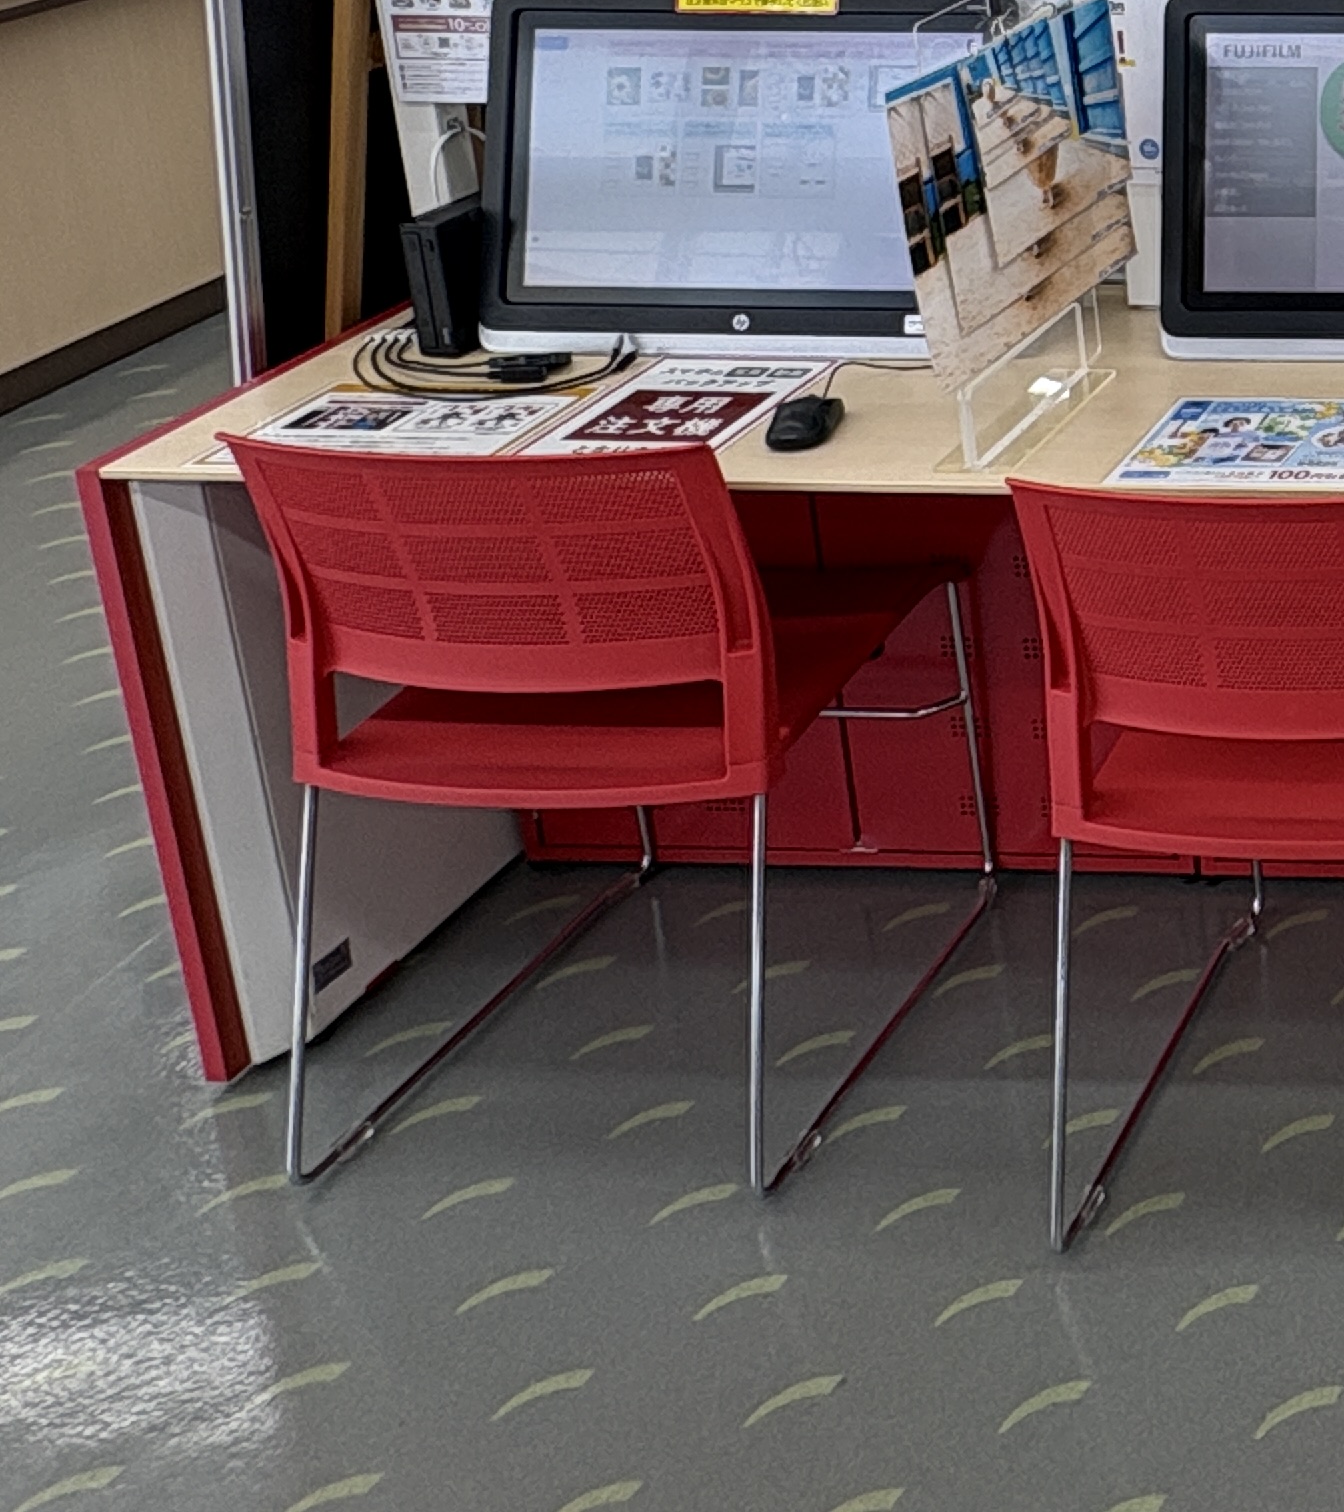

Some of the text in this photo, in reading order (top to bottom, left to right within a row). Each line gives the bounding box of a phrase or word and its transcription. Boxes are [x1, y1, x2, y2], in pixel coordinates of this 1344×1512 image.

[1222, 44, 1302, 59] FUJIFILM
[642, 394, 734, 414] 専用
[583, 415, 724, 436] 注文機
